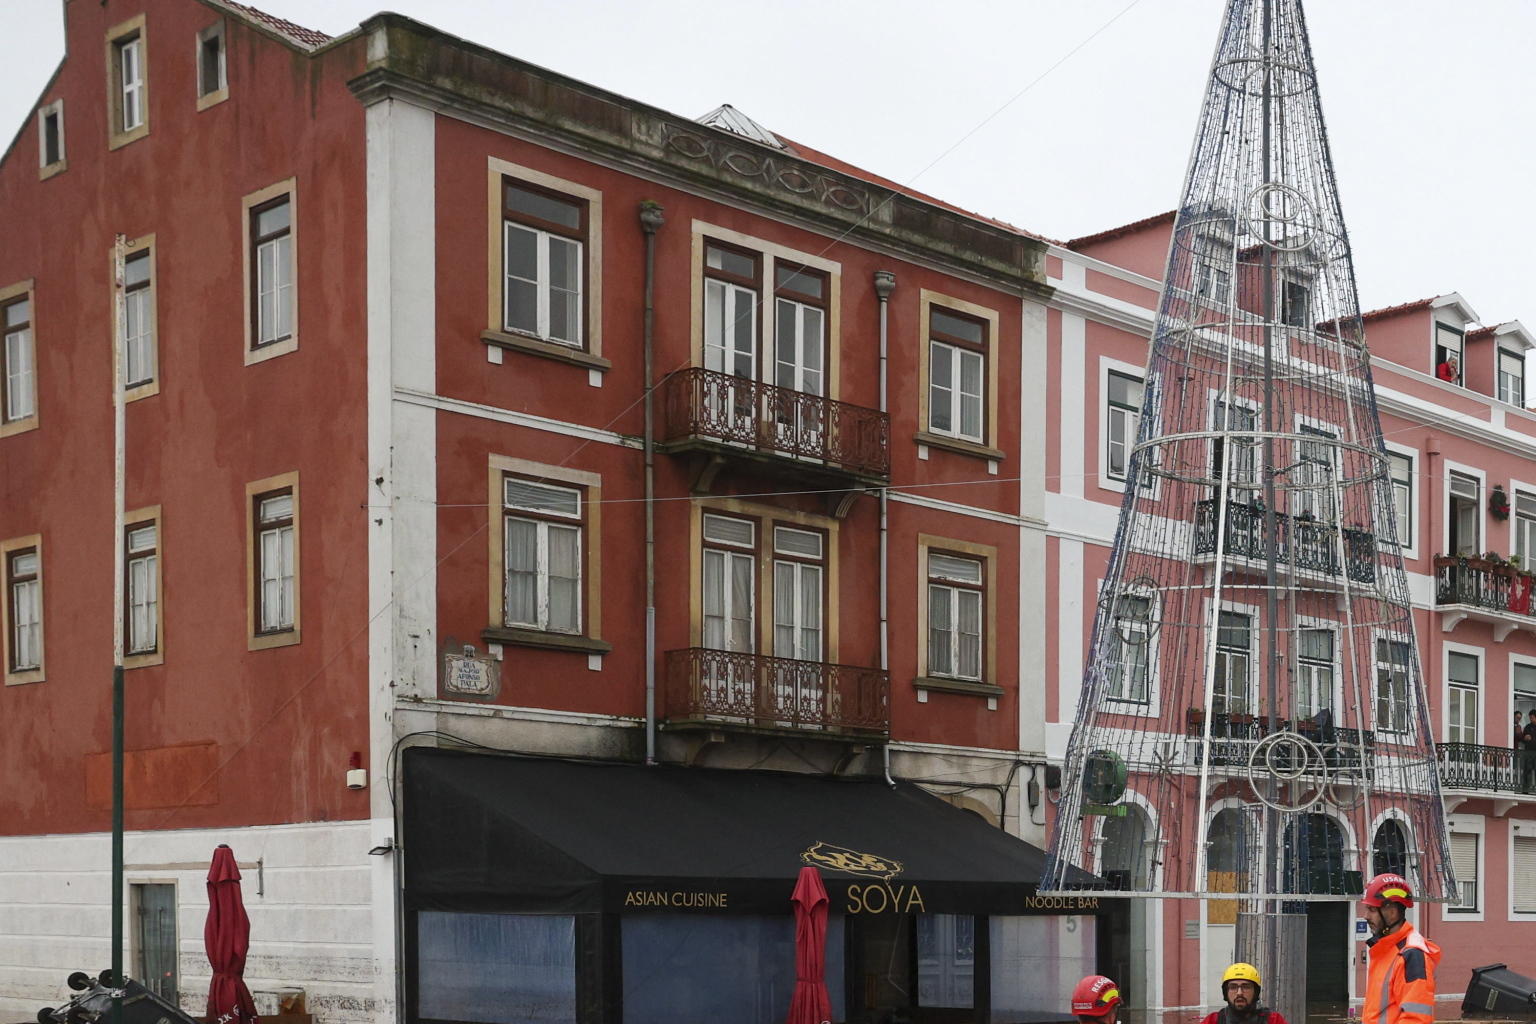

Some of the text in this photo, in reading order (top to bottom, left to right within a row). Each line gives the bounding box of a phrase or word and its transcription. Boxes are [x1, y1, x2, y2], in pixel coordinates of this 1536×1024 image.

[625, 891, 728, 908] ASIAN CUISINE
[847, 884, 926, 913] SOYA
[1025, 896, 1100, 909] NOODLE BAR
